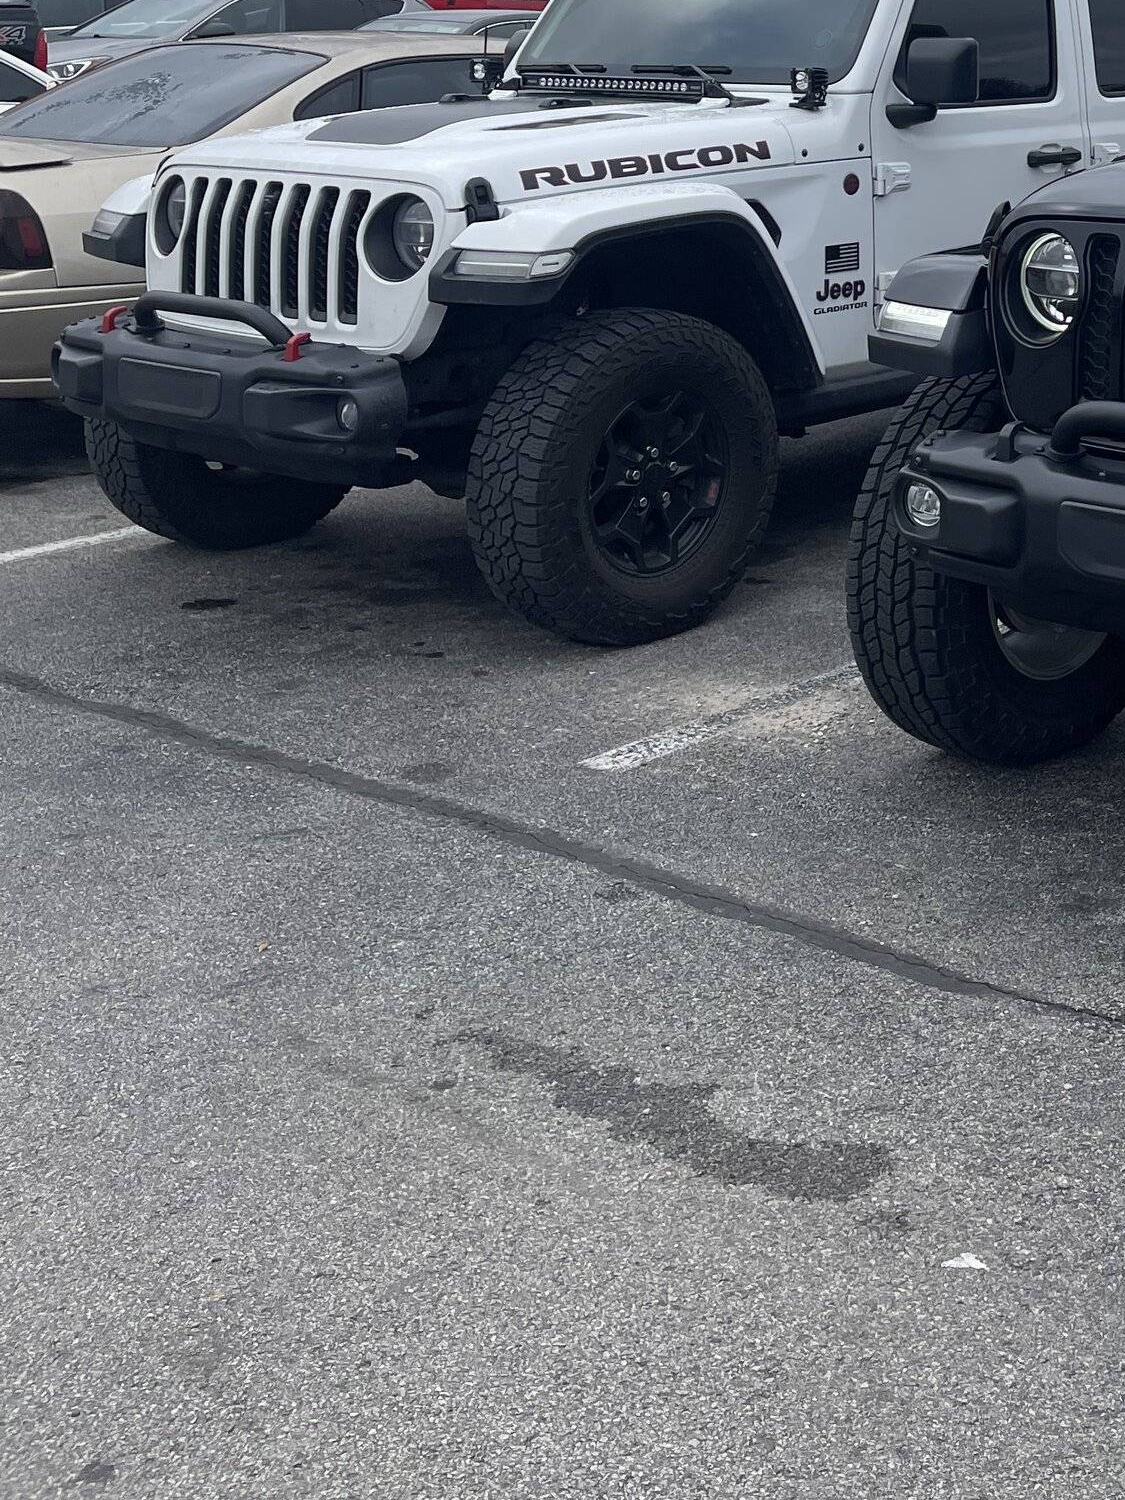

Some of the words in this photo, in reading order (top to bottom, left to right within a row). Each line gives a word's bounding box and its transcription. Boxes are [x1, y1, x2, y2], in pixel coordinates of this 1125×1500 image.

[518, 140, 771, 191] RUBICON
[816, 279, 865, 302] Jeep
[813, 301, 868, 315] GLADIATOR
